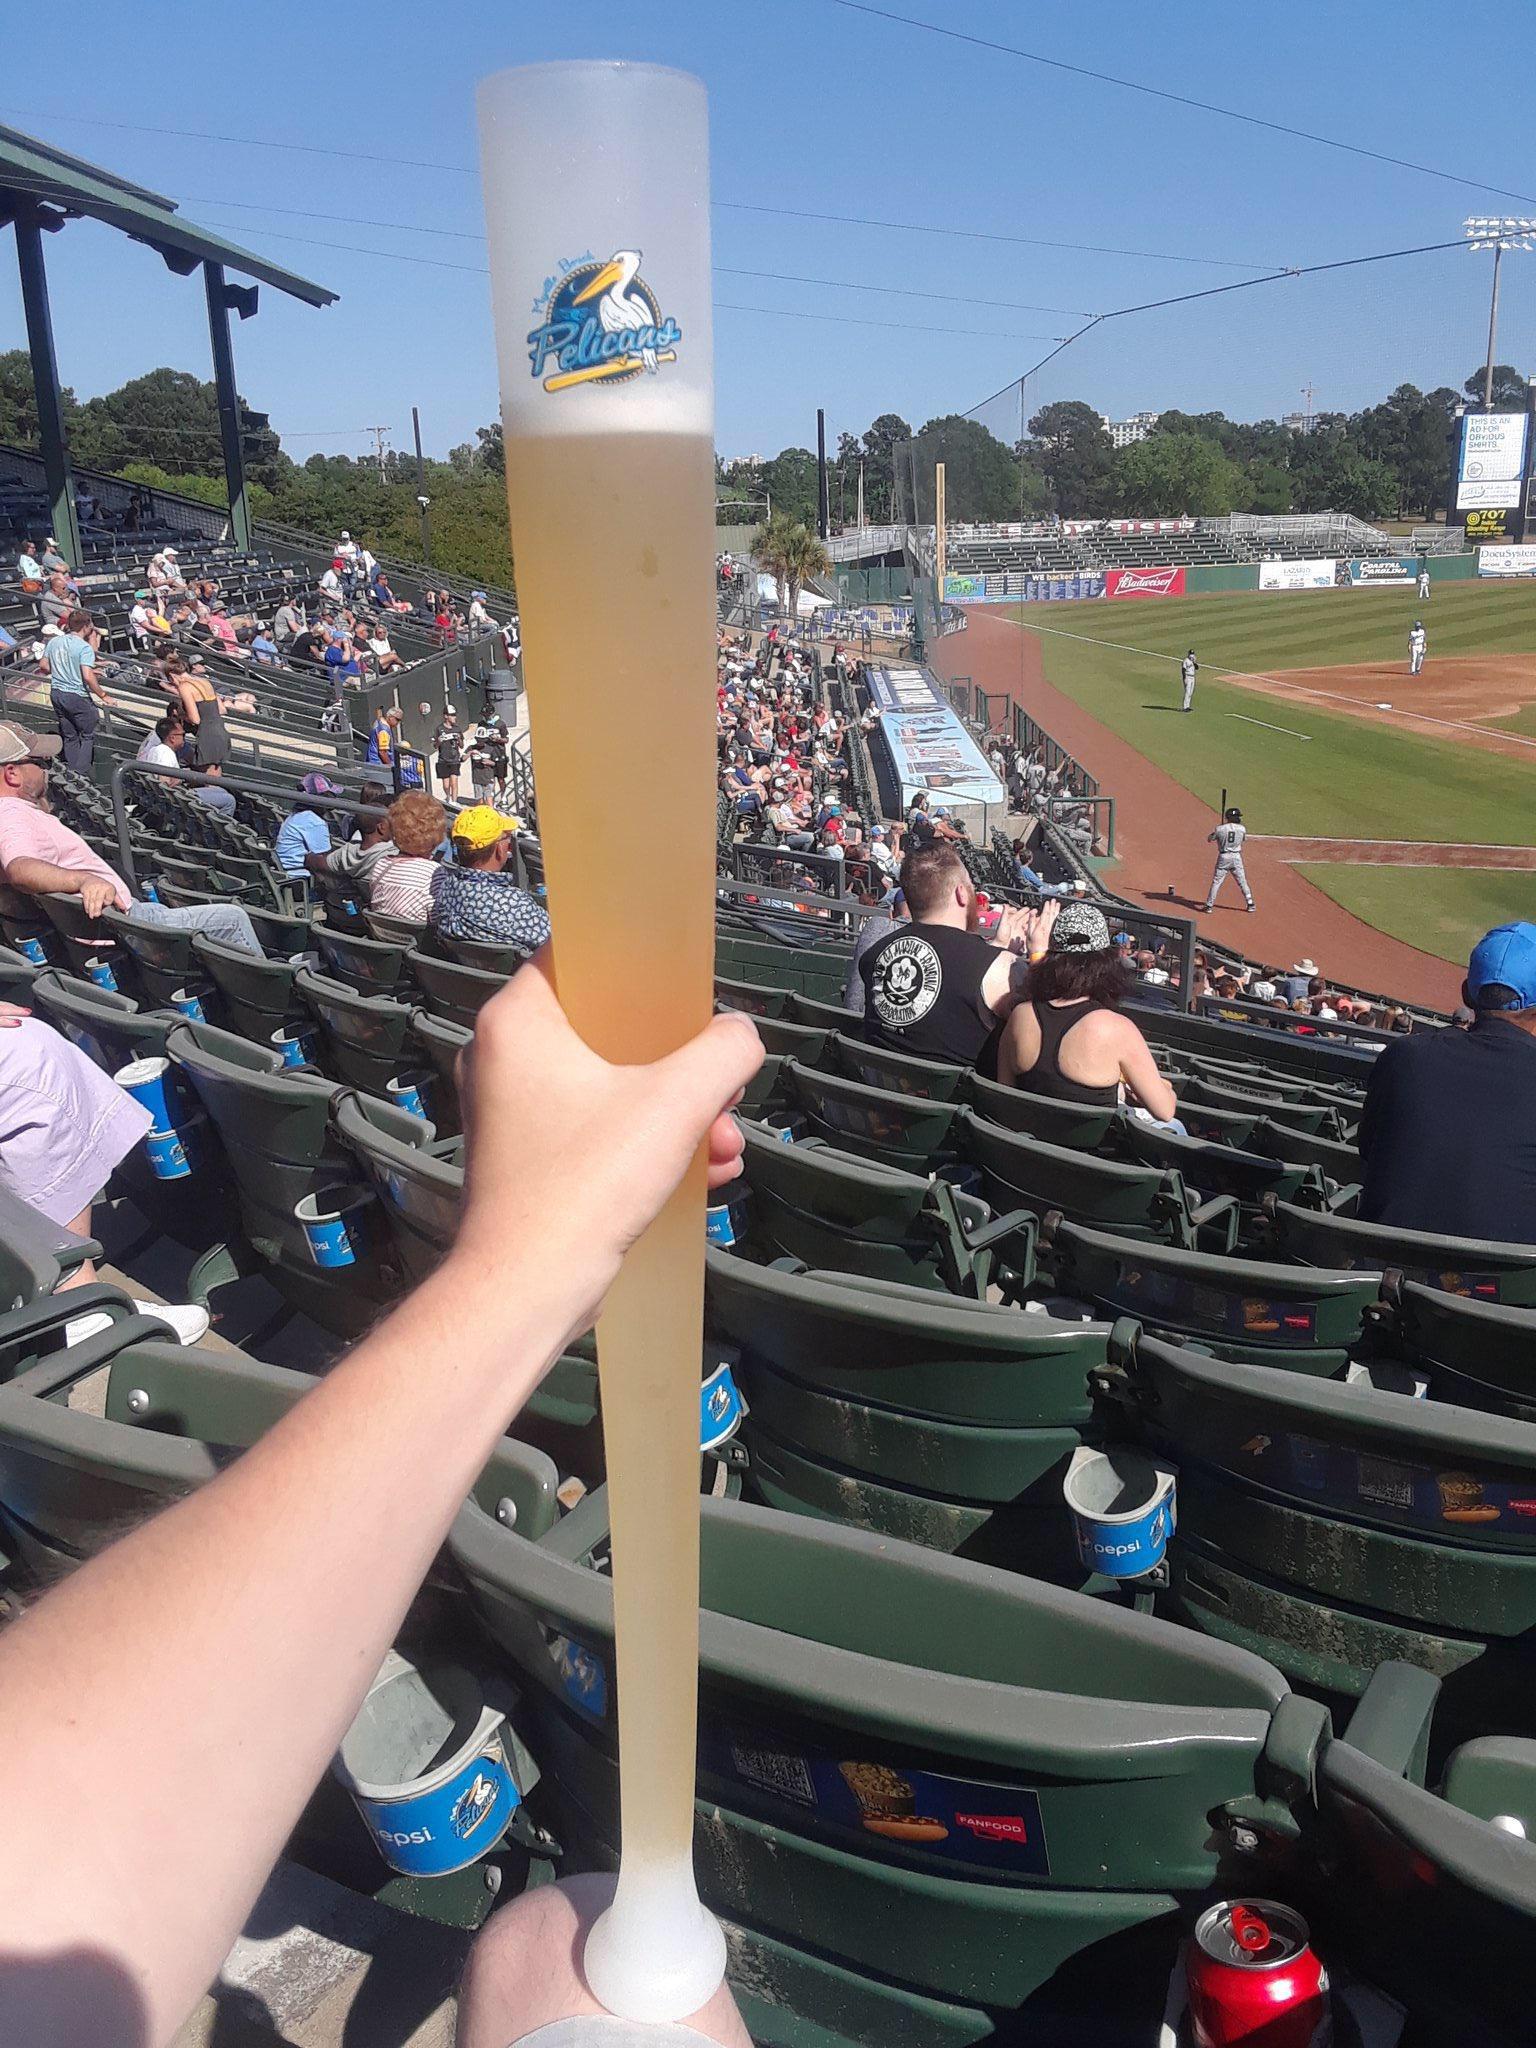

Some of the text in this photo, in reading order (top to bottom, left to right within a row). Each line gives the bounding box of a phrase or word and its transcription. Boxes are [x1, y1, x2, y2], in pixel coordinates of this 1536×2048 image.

[527, 316, 682, 377] Pelicans
[1470, 417, 1488, 425] THIS
[1489, 417, 1498, 425] IS
[1469, 425, 1500, 433] AD FOR
[1469, 433, 1505, 441] OBVIOUS
[1479, 509, 1507, 520] 707
[1359, 560, 1400, 571] COASTAL
[1032, 573, 1045, 581] WE
[1079, 571, 1101, 580] BIRDS
[1360, 567, 1408, 579] CAROLINA
[1118, 574, 1171, 589] Budweiser
[1227, 831, 1236, 843] 8
[1094, 1539, 1141, 1557] pepsi
[959, 1816, 1022, 1833] FANFOOD
